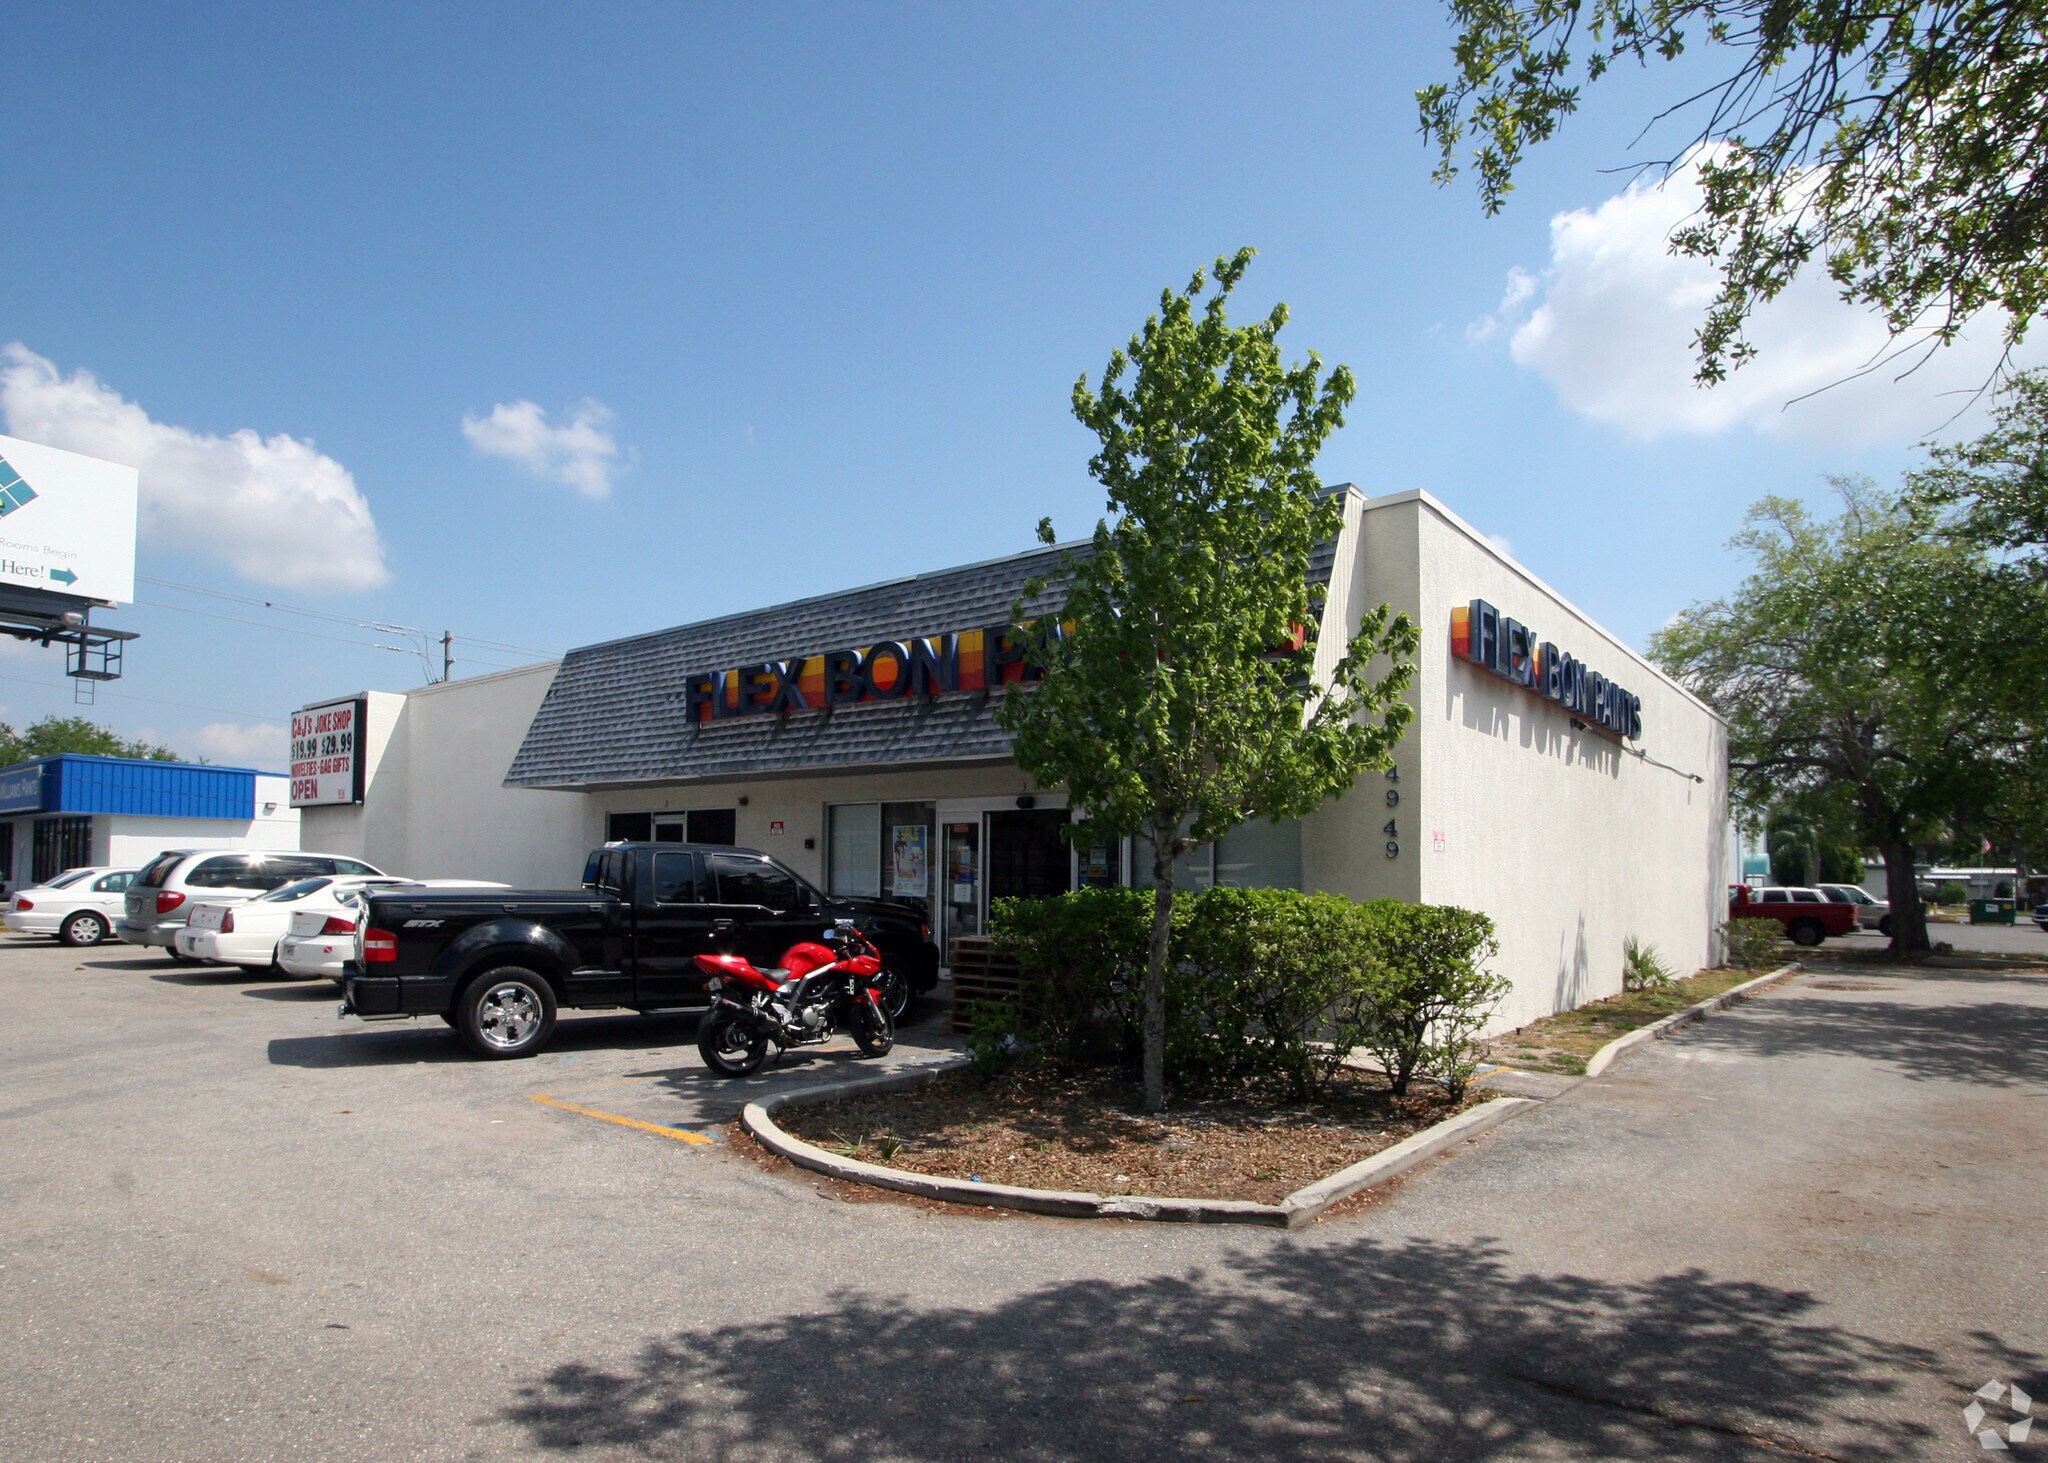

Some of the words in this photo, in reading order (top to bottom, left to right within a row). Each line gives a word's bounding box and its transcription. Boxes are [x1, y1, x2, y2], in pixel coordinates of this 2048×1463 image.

[43, 545, 77, 560] Begin
[1, 558, 44, 578] Here!
[685, 658, 809, 723] FLEX
[824, 633, 960, 704] BON
[1470, 598, 1538, 689] FLEX
[1539, 641, 1588, 714] BON
[1586, 671, 1642, 741] PAINTS
[315, 712, 331, 734] JOKE
[332, 710, 351, 731] SHOP
[291, 738, 317, 760] $19.99
[321, 732, 352, 755] $29.99
[333, 757, 349, 773] GIFTS
[291, 779, 318, 800] OPEN
